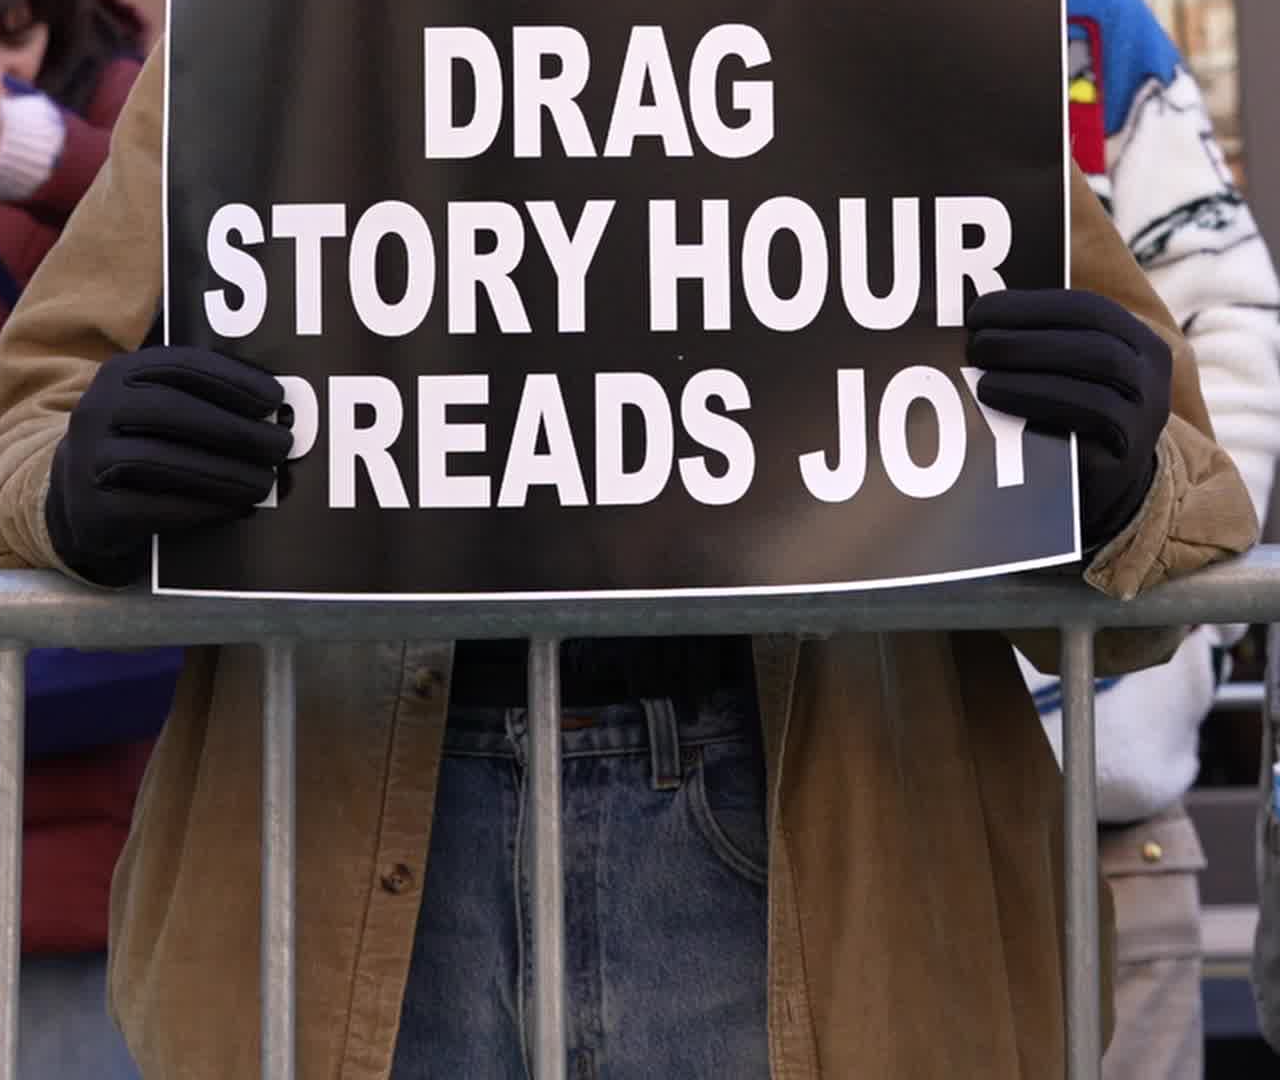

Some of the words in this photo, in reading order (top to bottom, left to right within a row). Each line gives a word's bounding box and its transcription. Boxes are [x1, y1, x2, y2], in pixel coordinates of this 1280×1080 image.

[424, 24, 774, 159] DRAG
[203, 199, 616, 338] STORY
[648, 196, 1013, 332] HOUR
[253, 369, 757, 509] PREADS
[798, 365, 1026, 503] JOY
